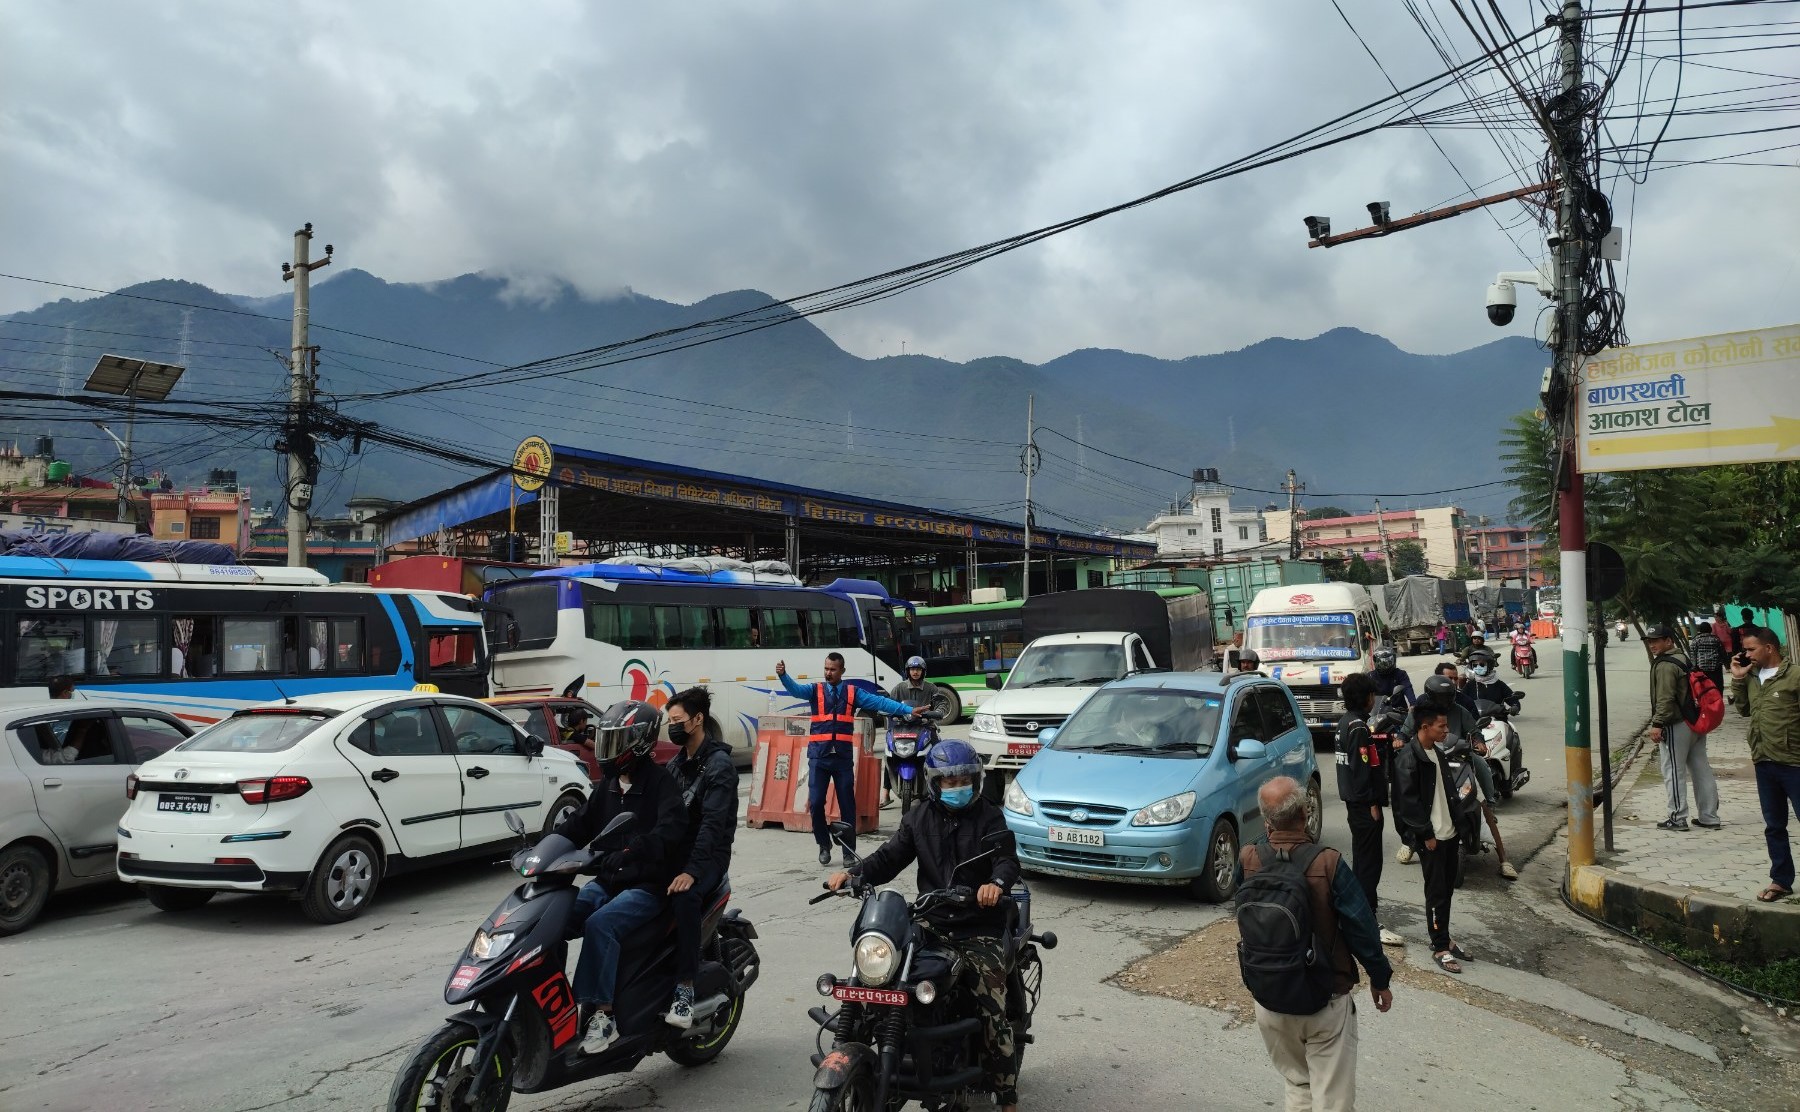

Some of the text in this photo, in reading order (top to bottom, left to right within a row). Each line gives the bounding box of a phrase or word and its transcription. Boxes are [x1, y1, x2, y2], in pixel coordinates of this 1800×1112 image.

[1683, 336, 1763, 364] कोलोनी
[1587, 373, 1686, 405] बाणस्थली
[1588, 400, 1711, 430] आकाश टोल
[25, 586, 154, 610] SPORTS
[1057, 831, 1063, 840] B
